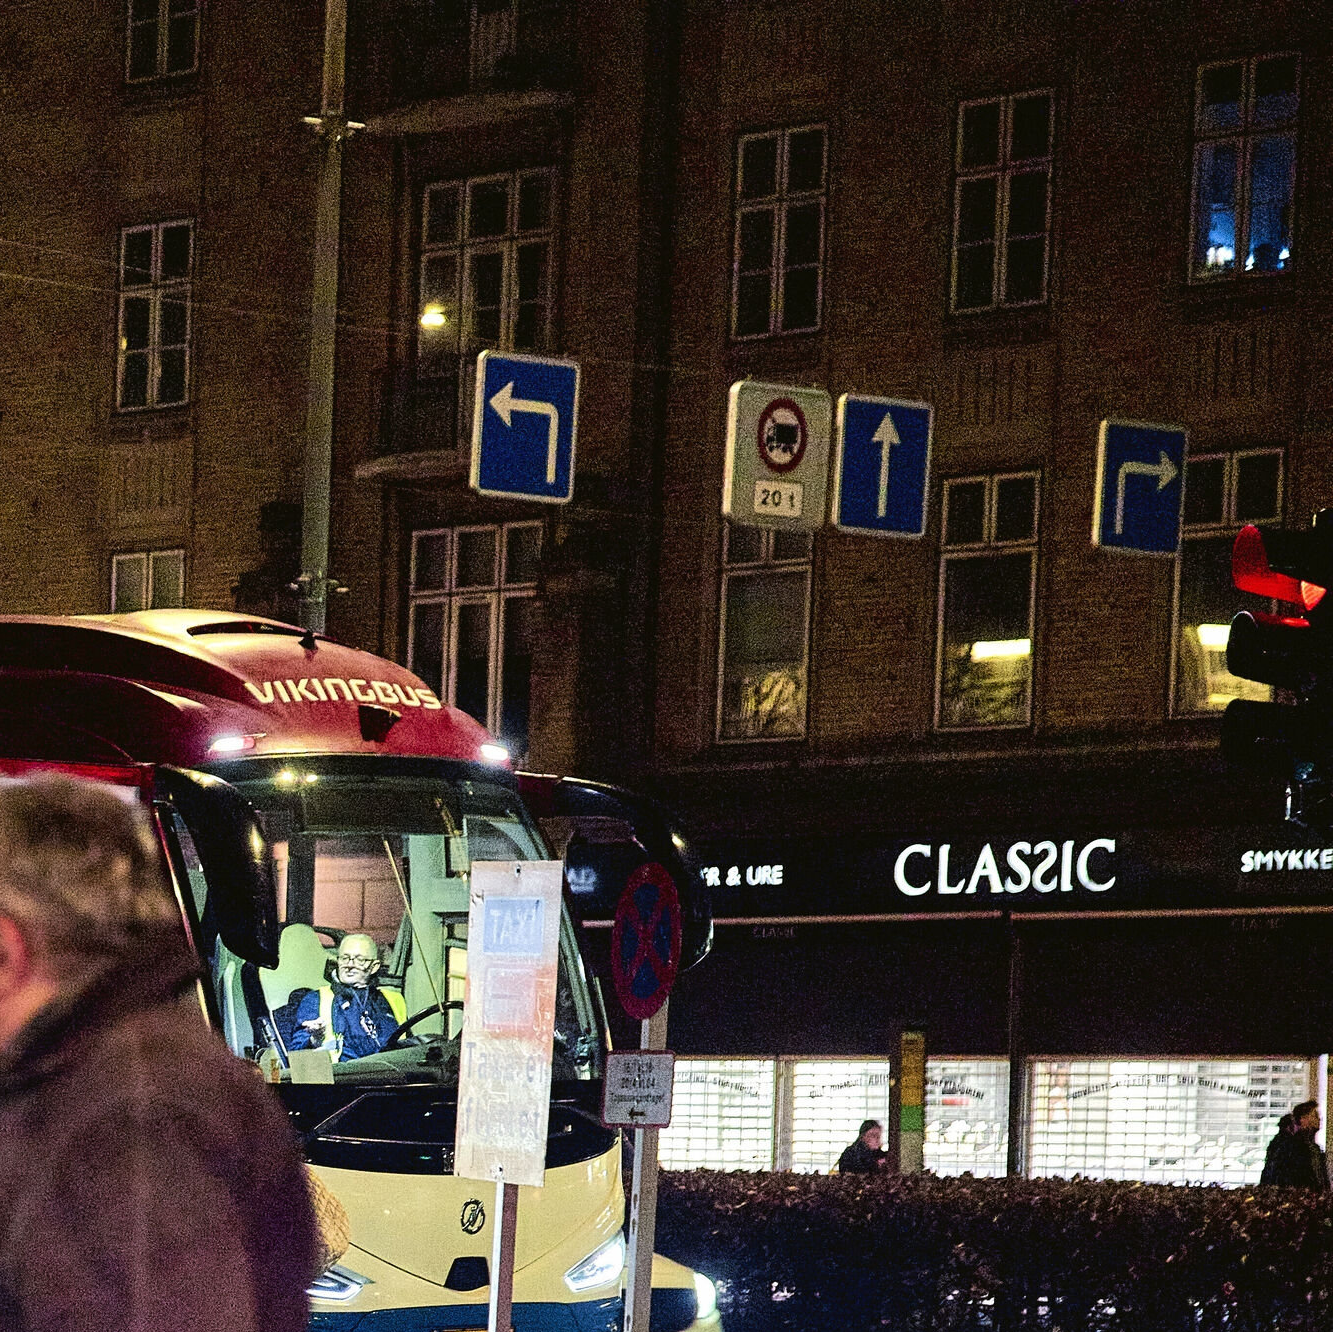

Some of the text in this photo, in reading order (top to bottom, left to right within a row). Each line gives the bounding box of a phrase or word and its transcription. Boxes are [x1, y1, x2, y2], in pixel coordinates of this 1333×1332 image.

[761, 488, 796, 508] 20 t
[244, 677, 443, 711] VIKINGBUS
[725, 865, 742, 887] &
[746, 864, 784, 887] URE
[893, 837, 1117, 897] CLASSIC
